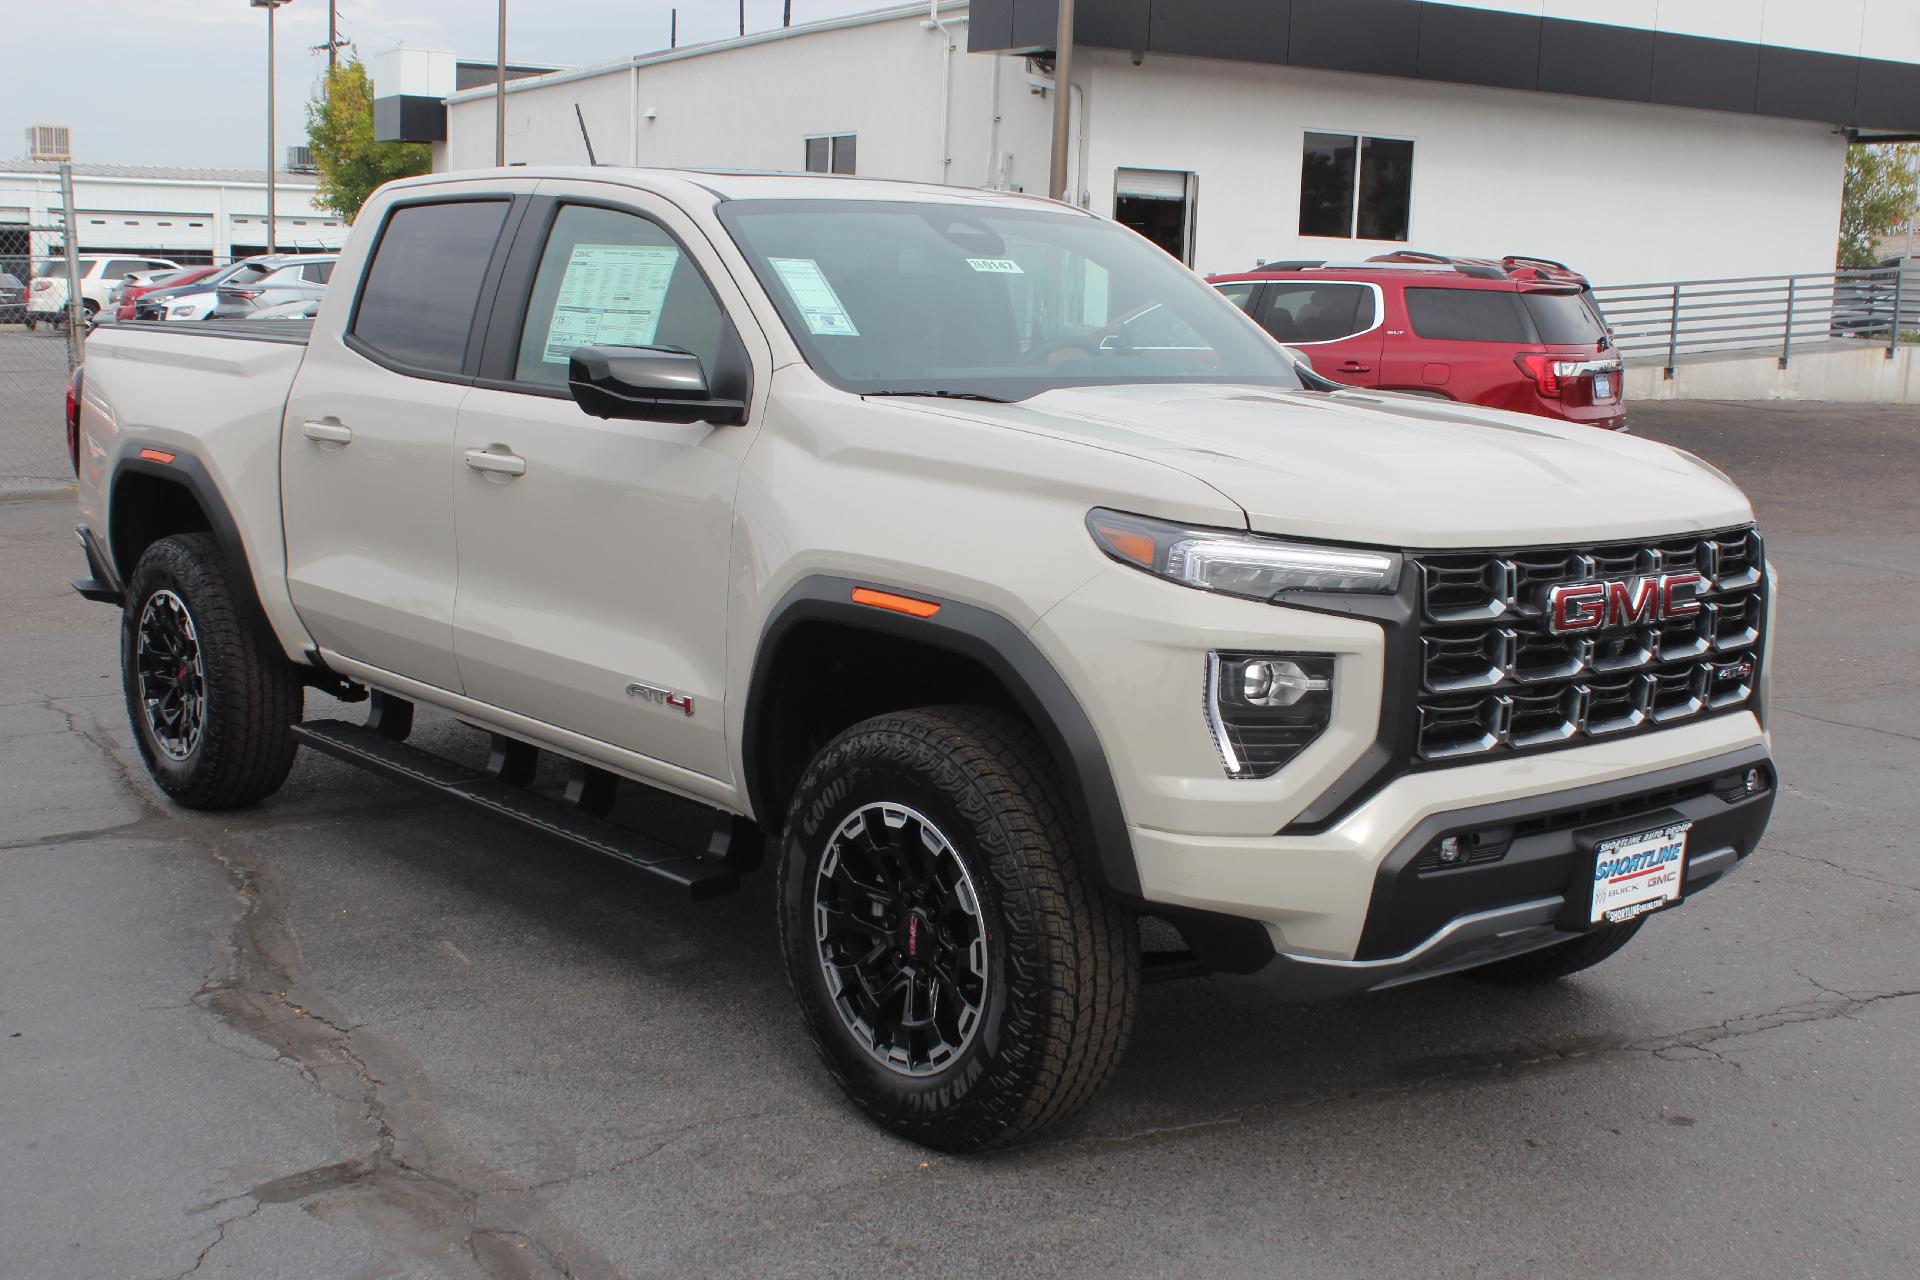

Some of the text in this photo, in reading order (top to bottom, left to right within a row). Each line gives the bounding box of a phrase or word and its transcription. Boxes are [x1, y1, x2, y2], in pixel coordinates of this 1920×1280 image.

[1548, 573, 1702, 635] GMC
[625, 681, 696, 717] AT4
[1600, 822, 1693, 852] SHORTLINE AUTO GROUP
[1595, 842, 1683, 881] SHORTLINE
[1608, 872, 1676, 897] BUICK GMC
